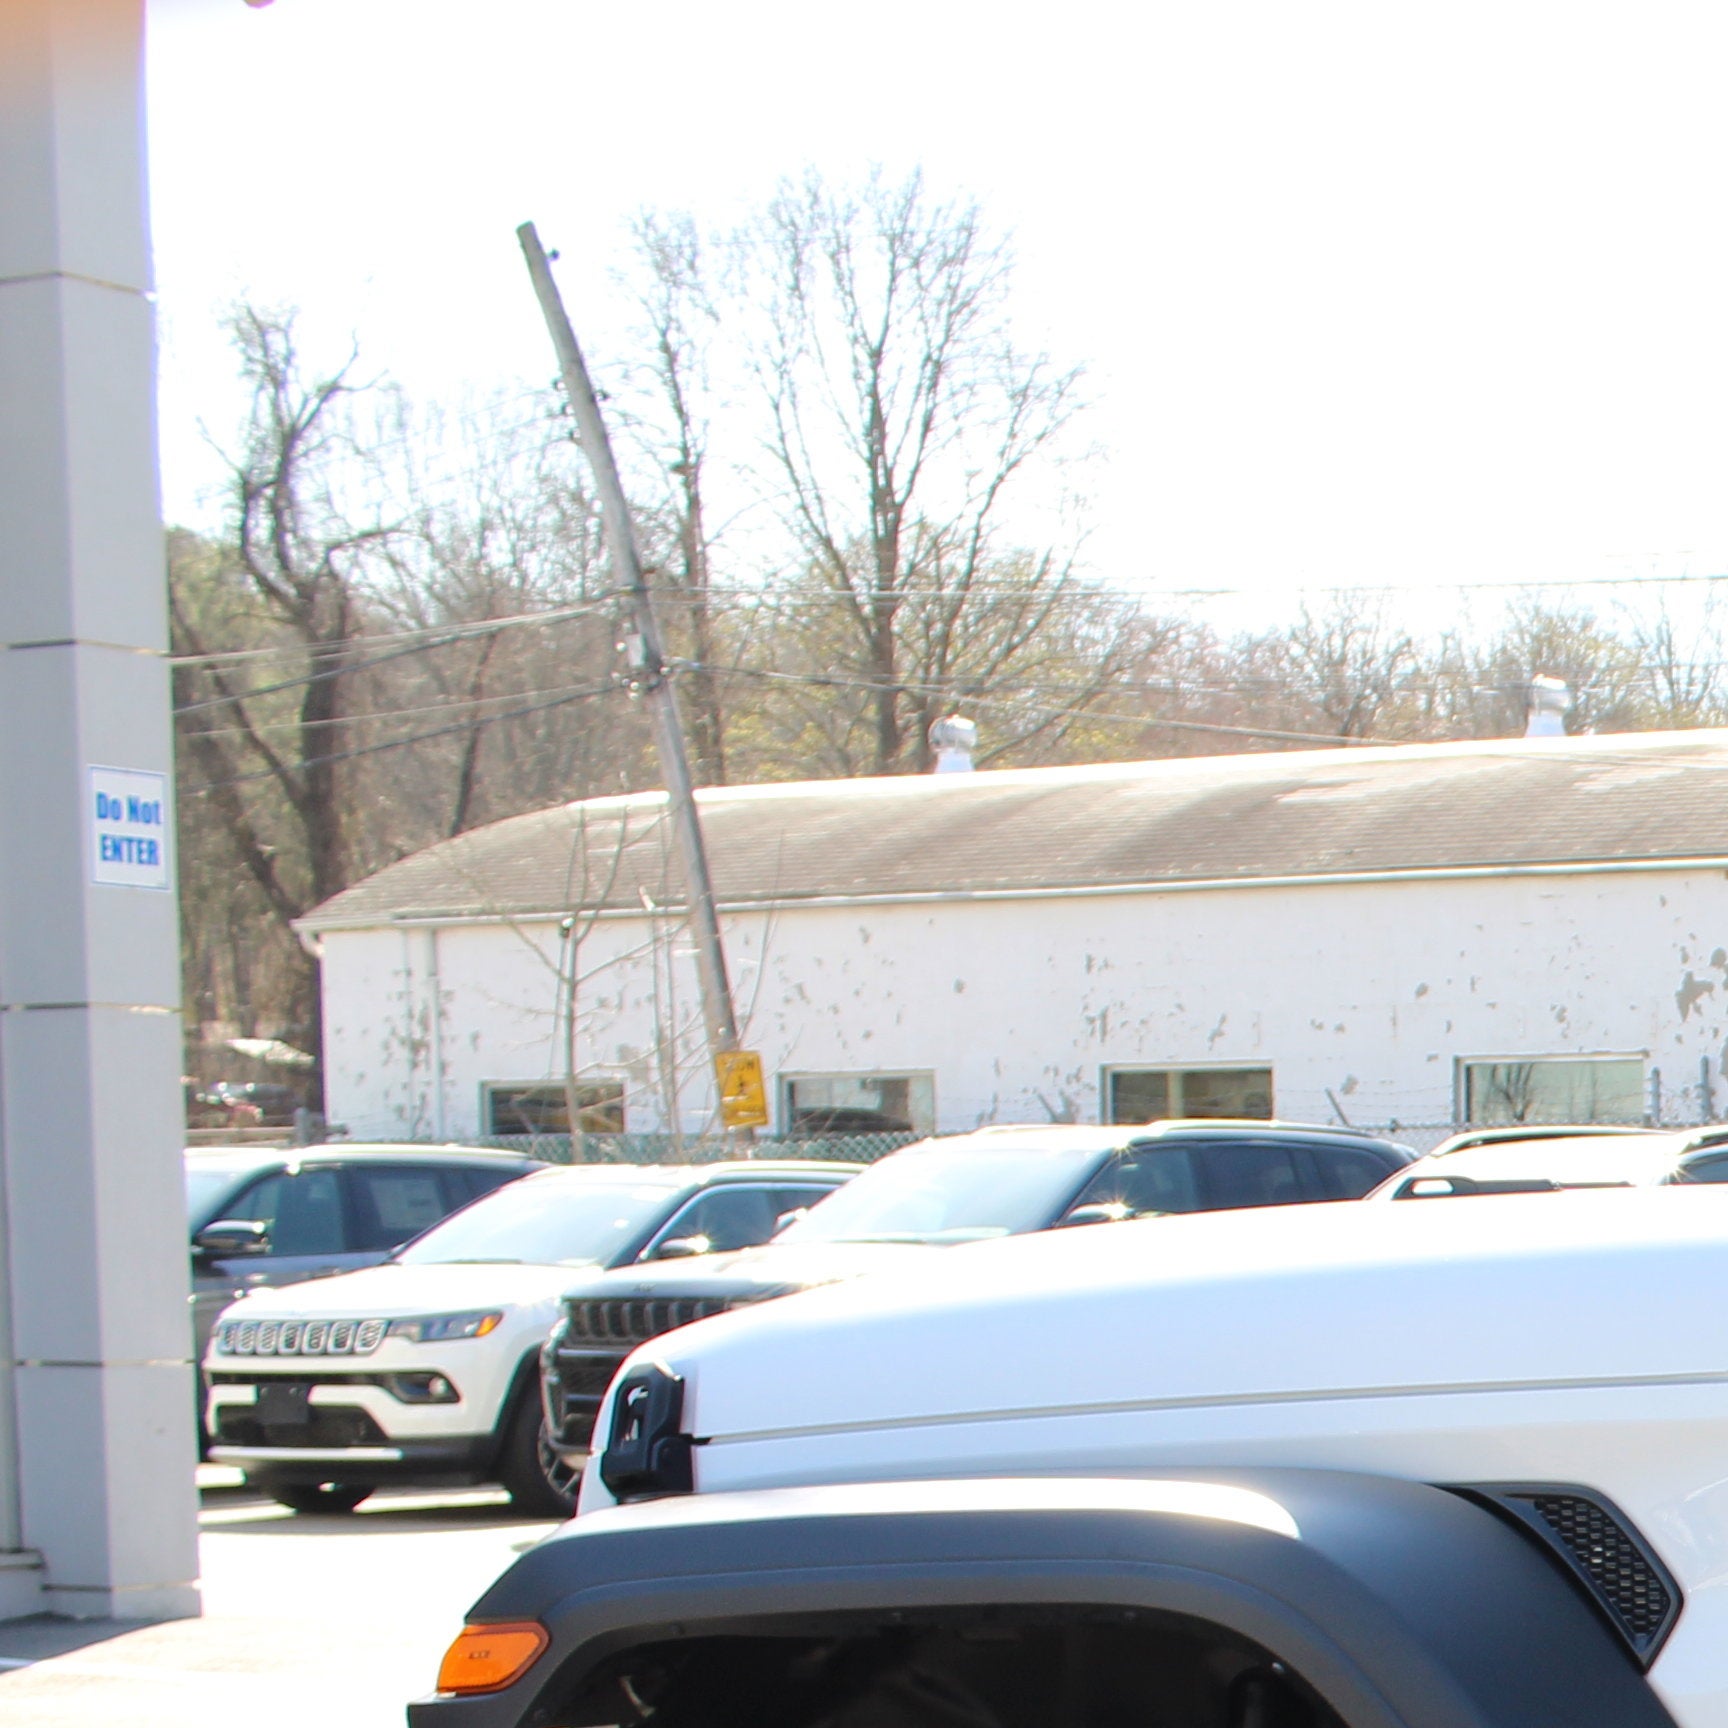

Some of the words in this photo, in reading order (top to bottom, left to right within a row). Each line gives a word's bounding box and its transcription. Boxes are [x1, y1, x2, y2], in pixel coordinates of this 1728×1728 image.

[96, 791, 122, 821] Do
[126, 794, 161, 825] Not
[100, 833, 159, 866] ENTER
